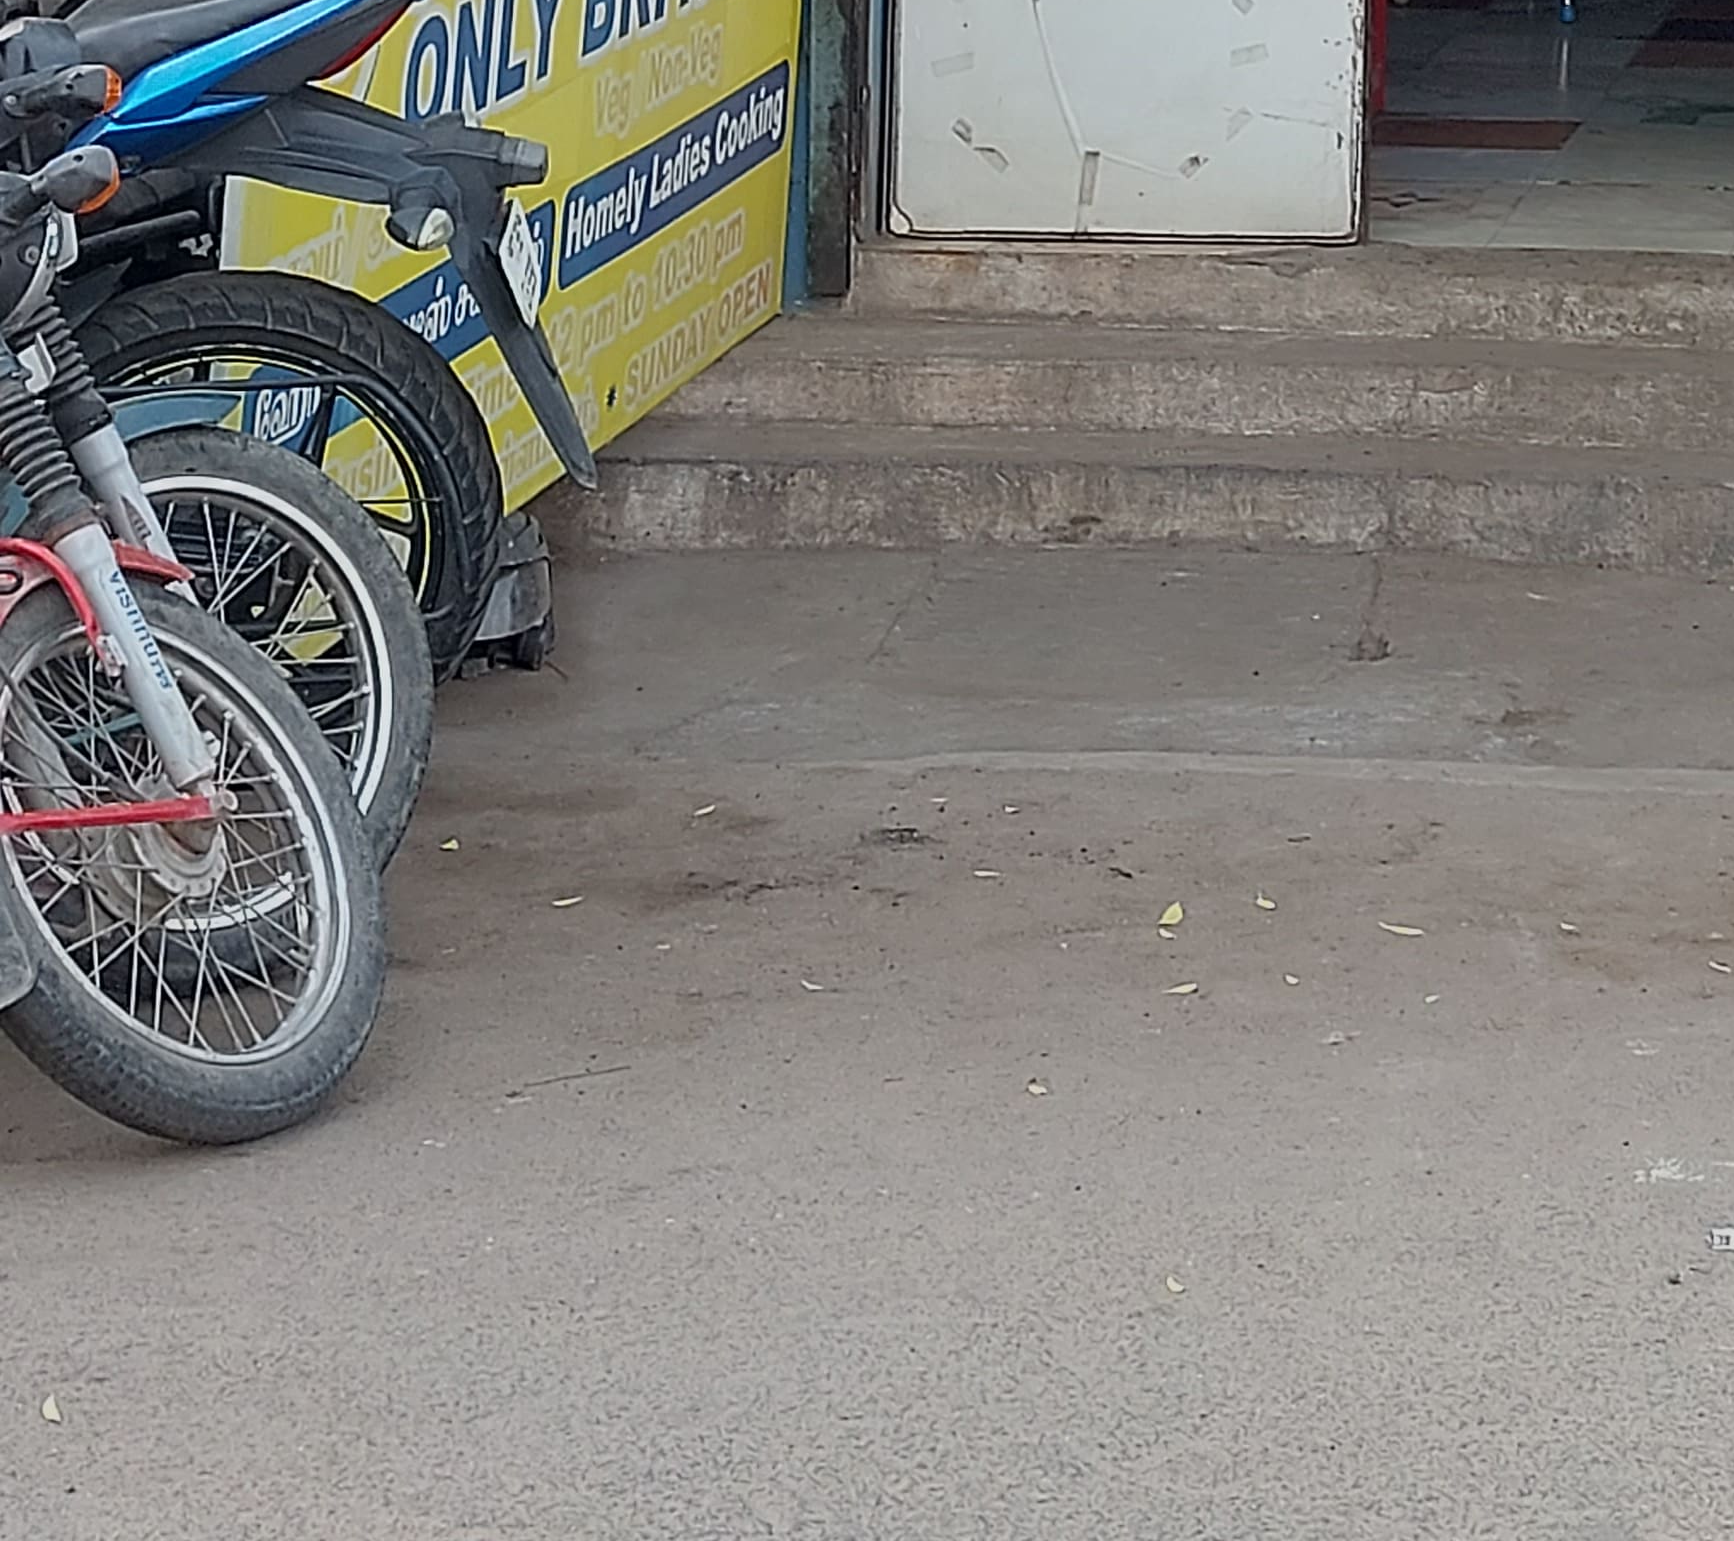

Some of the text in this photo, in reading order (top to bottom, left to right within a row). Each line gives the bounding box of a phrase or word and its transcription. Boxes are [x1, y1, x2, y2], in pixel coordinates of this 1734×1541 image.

[595, 73, 632, 139] Veg
[649, 24, 723, 101] Non-Veg
[565, 166, 648, 259] Homely
[650, 131, 710, 210] Ladies
[715, 85, 785, 165] Cooking
[579, 293, 617, 374] pm
[622, 271, 646, 333] to
[712, 207, 745, 282] pm
[624, 302, 714, 409] SUNDAY
[717, 259, 773, 341] OPEN
